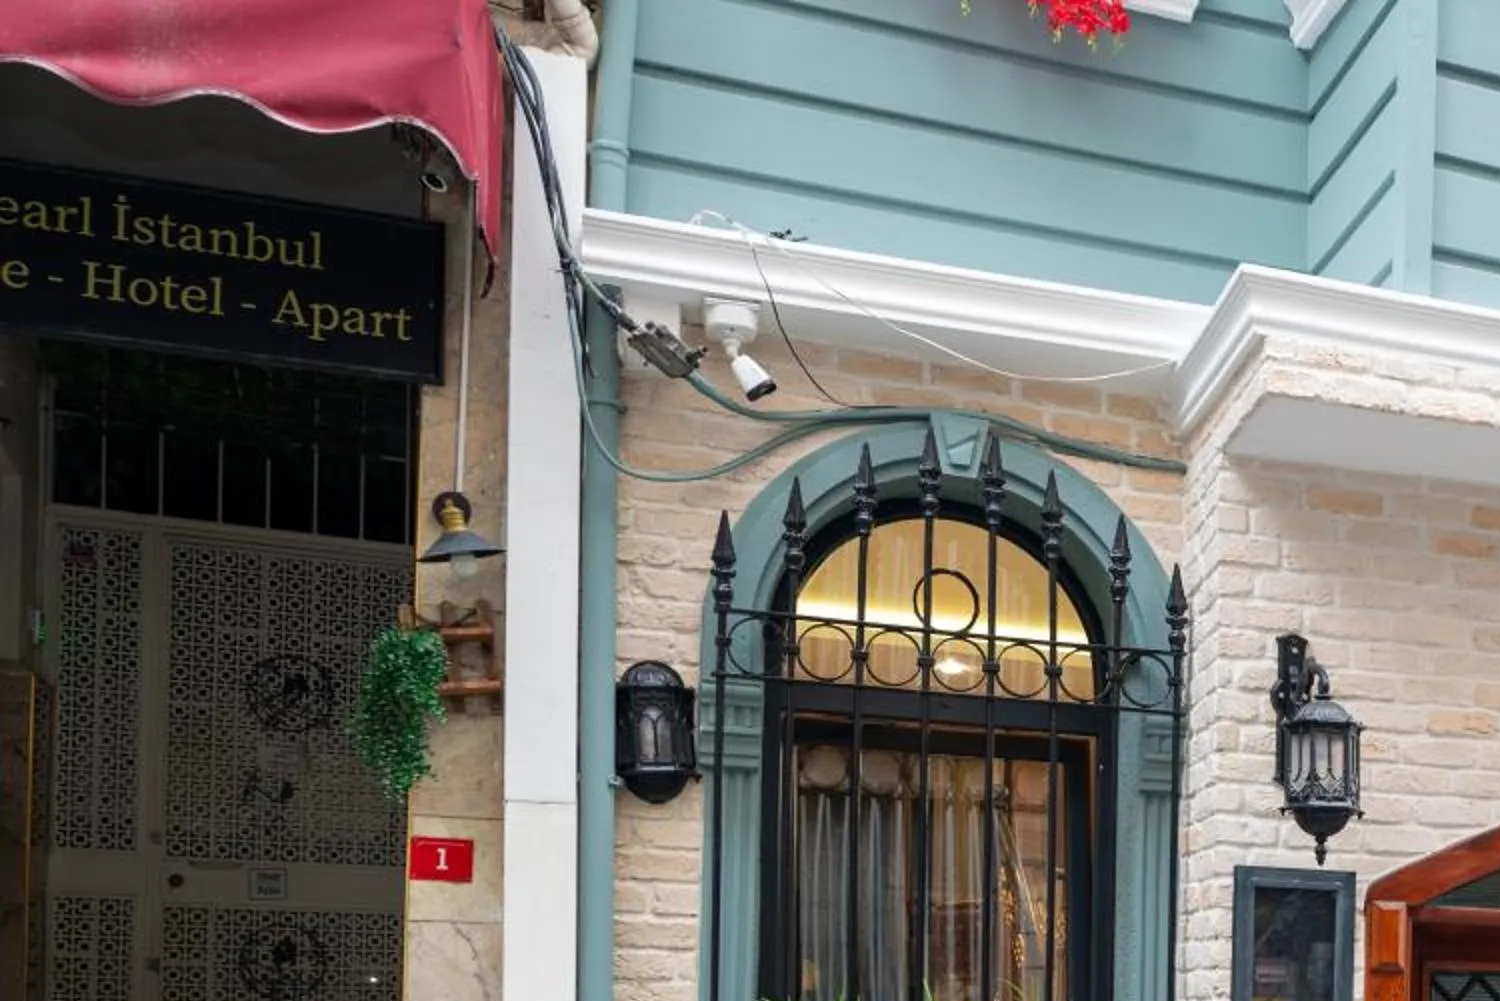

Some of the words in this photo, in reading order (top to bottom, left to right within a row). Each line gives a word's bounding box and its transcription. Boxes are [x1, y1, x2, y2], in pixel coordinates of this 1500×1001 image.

[111, 194, 325, 270] İstanbul
[80, 260, 225, 316] Hotel
[271, 289, 413, 342] Apart
[436, 847, 449, 871] 1
